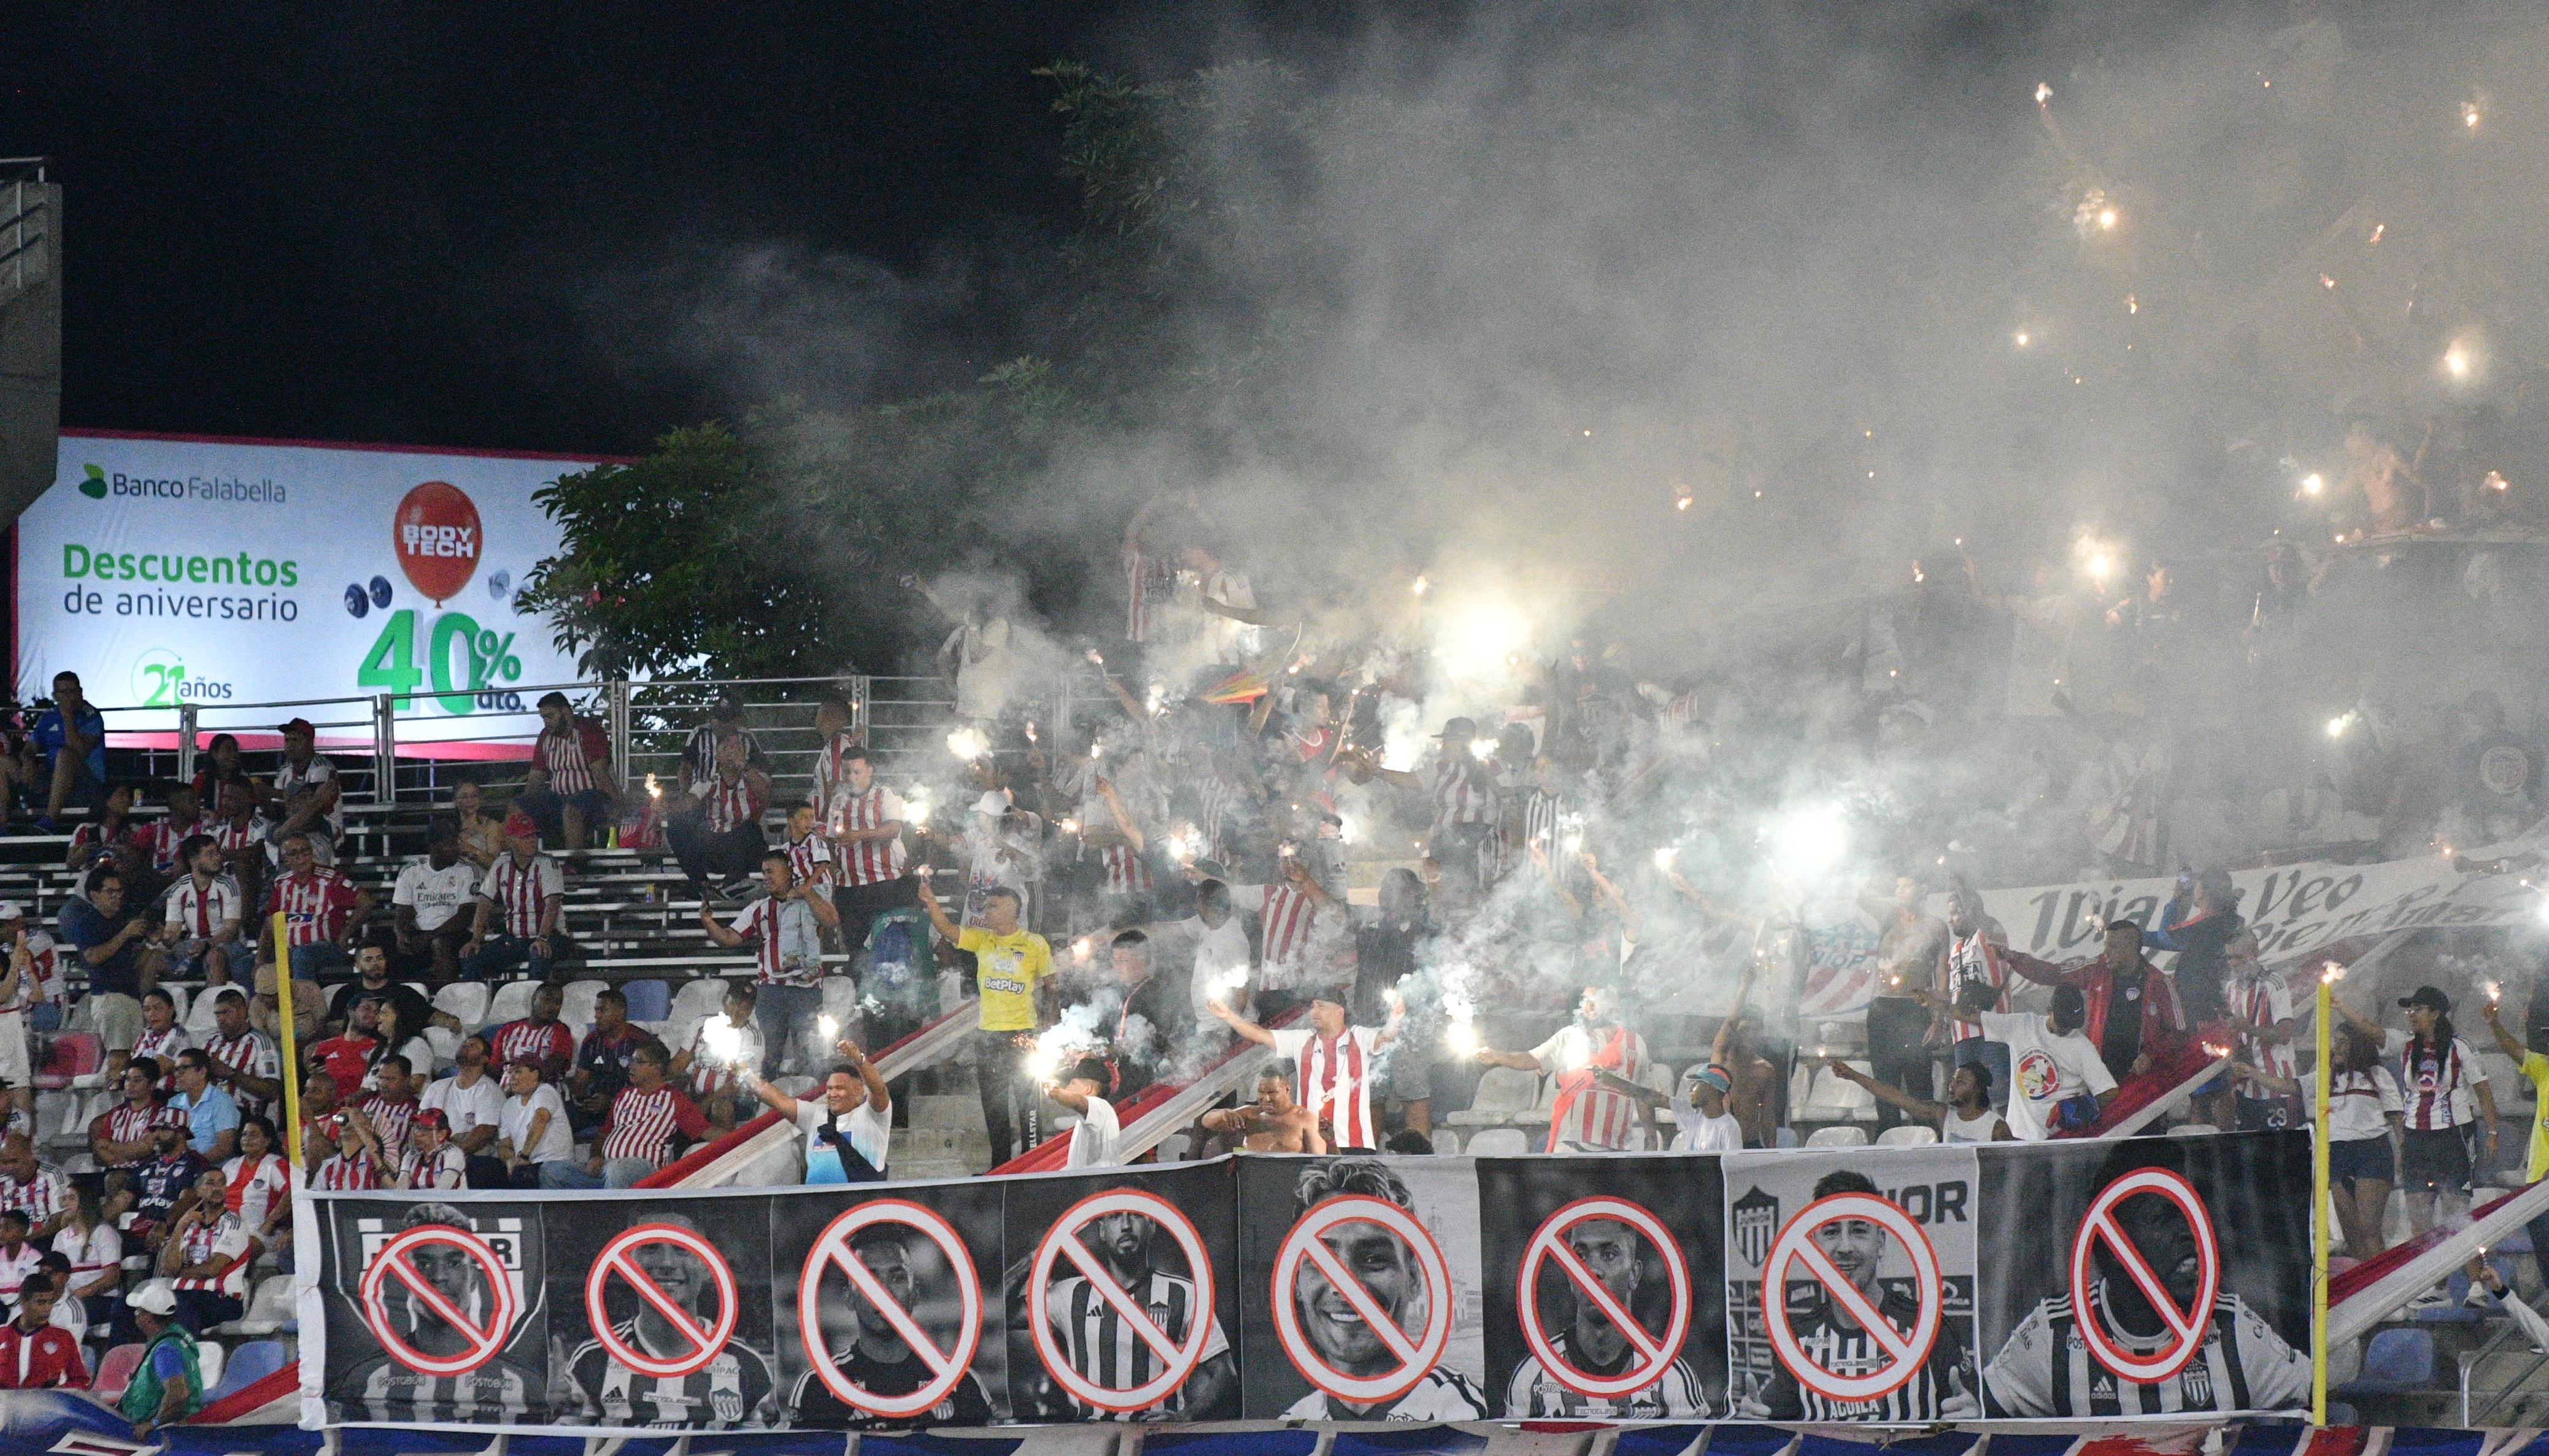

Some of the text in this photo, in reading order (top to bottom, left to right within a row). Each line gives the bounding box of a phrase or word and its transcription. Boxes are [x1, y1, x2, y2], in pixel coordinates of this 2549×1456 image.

[113, 473, 287, 503] Banco Falabella
[403, 525, 472, 542] BODY
[403, 540, 474, 558] TECH
[64, 544, 298, 587] Descuentos
[64, 584, 298, 622] de aniversario
[180, 677, 232, 699] años
[417, 892, 457, 902] Emirates
[985, 976, 1025, 995] BetPlay
[2267, 1107, 2287, 1127] 29
[2091, 1391, 2116, 1400] adidas
